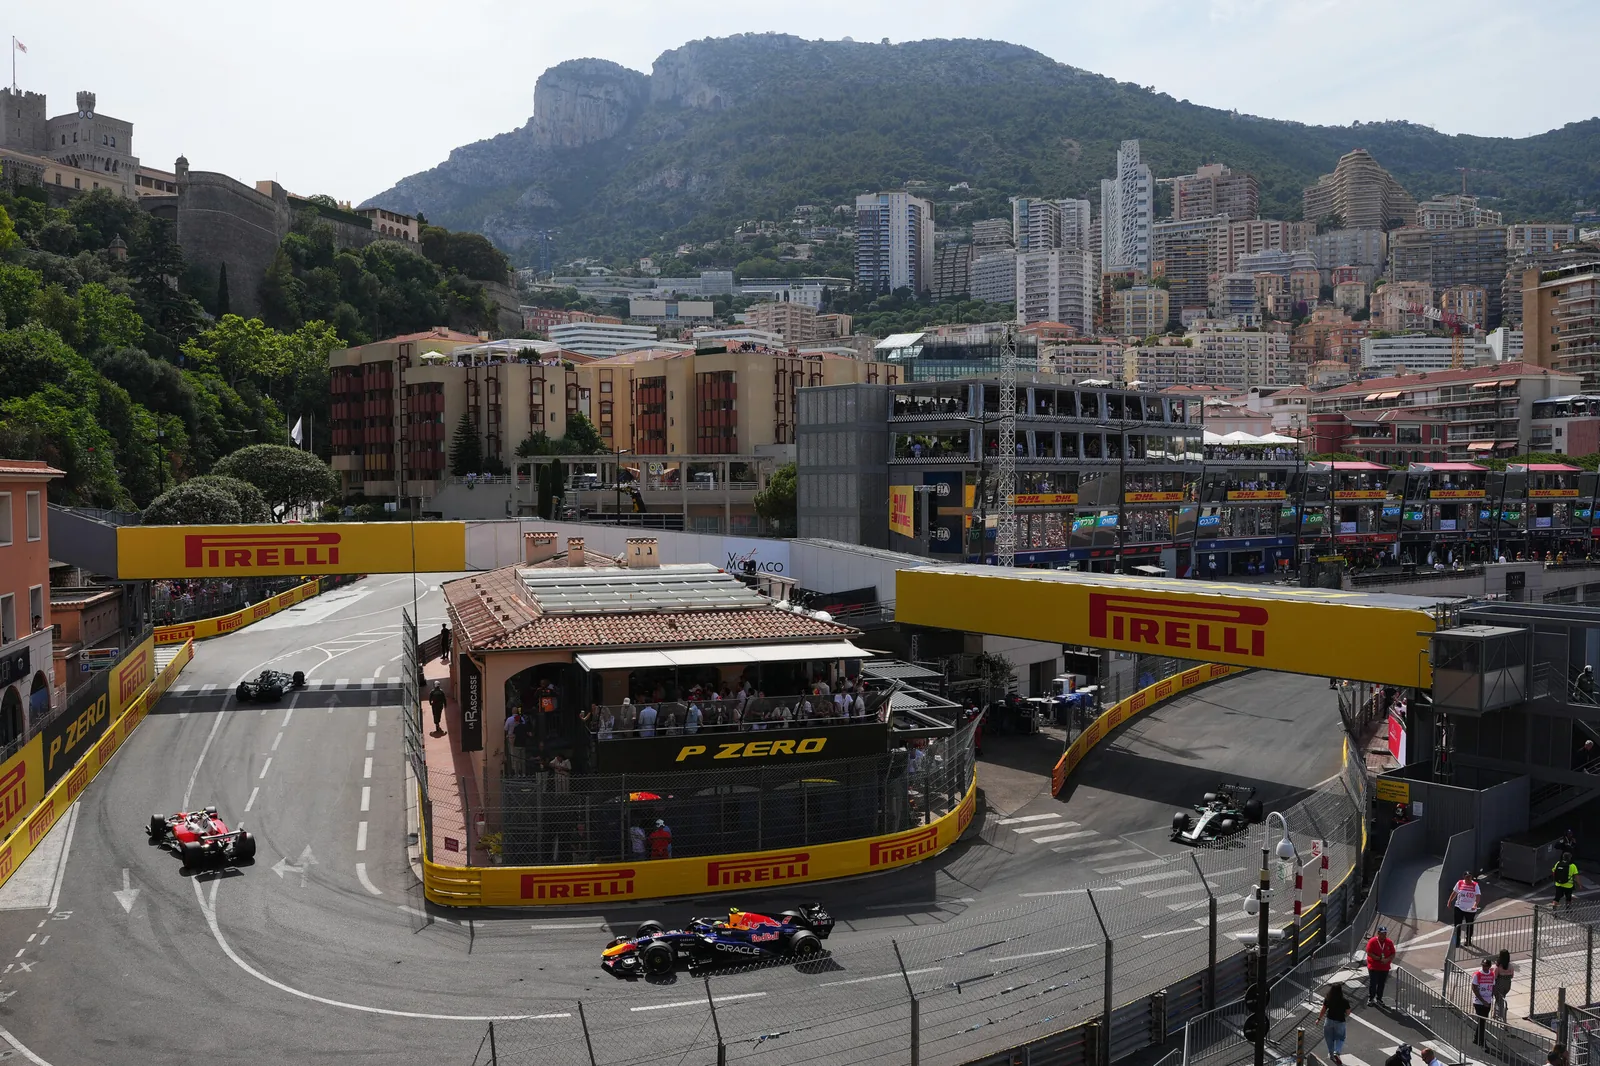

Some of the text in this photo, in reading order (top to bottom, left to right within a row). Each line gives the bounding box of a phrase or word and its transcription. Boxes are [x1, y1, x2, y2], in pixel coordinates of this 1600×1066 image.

[1017, 495, 1041, 503] DHL
[185, 532, 341, 567] PIRELLI
[726, 561, 784, 572] MOACO
[217, 613, 243, 631] PIRELLI
[254, 602, 270, 618] PIRELLI
[1089, 592, 1269, 657] PIRELLI
[119, 650, 147, 706] PIRELLI
[1155, 681, 1172, 699] PIRELLI
[1182, 670, 1200, 687] PIRELLI
[464, 675, 477, 722] RASCASSE
[1130, 693, 1146, 713] PIRELLI
[49, 693, 107, 771] P ZERO
[124, 704, 139, 734] PIRELLI
[1107, 707, 1122, 728] PIRELLI
[98, 730, 116, 765] PIRELLI
[675, 737, 827, 761] P ZERO
[67, 762, 88, 802] PIRELLI
[29, 799, 54, 846] PIRELLI
[870, 827, 938, 866] PIRELLI
[521, 868, 636, 899] PIRELLI
[707, 852, 810, 886] PIRELLI
[715, 943, 760, 956] ORACLE
